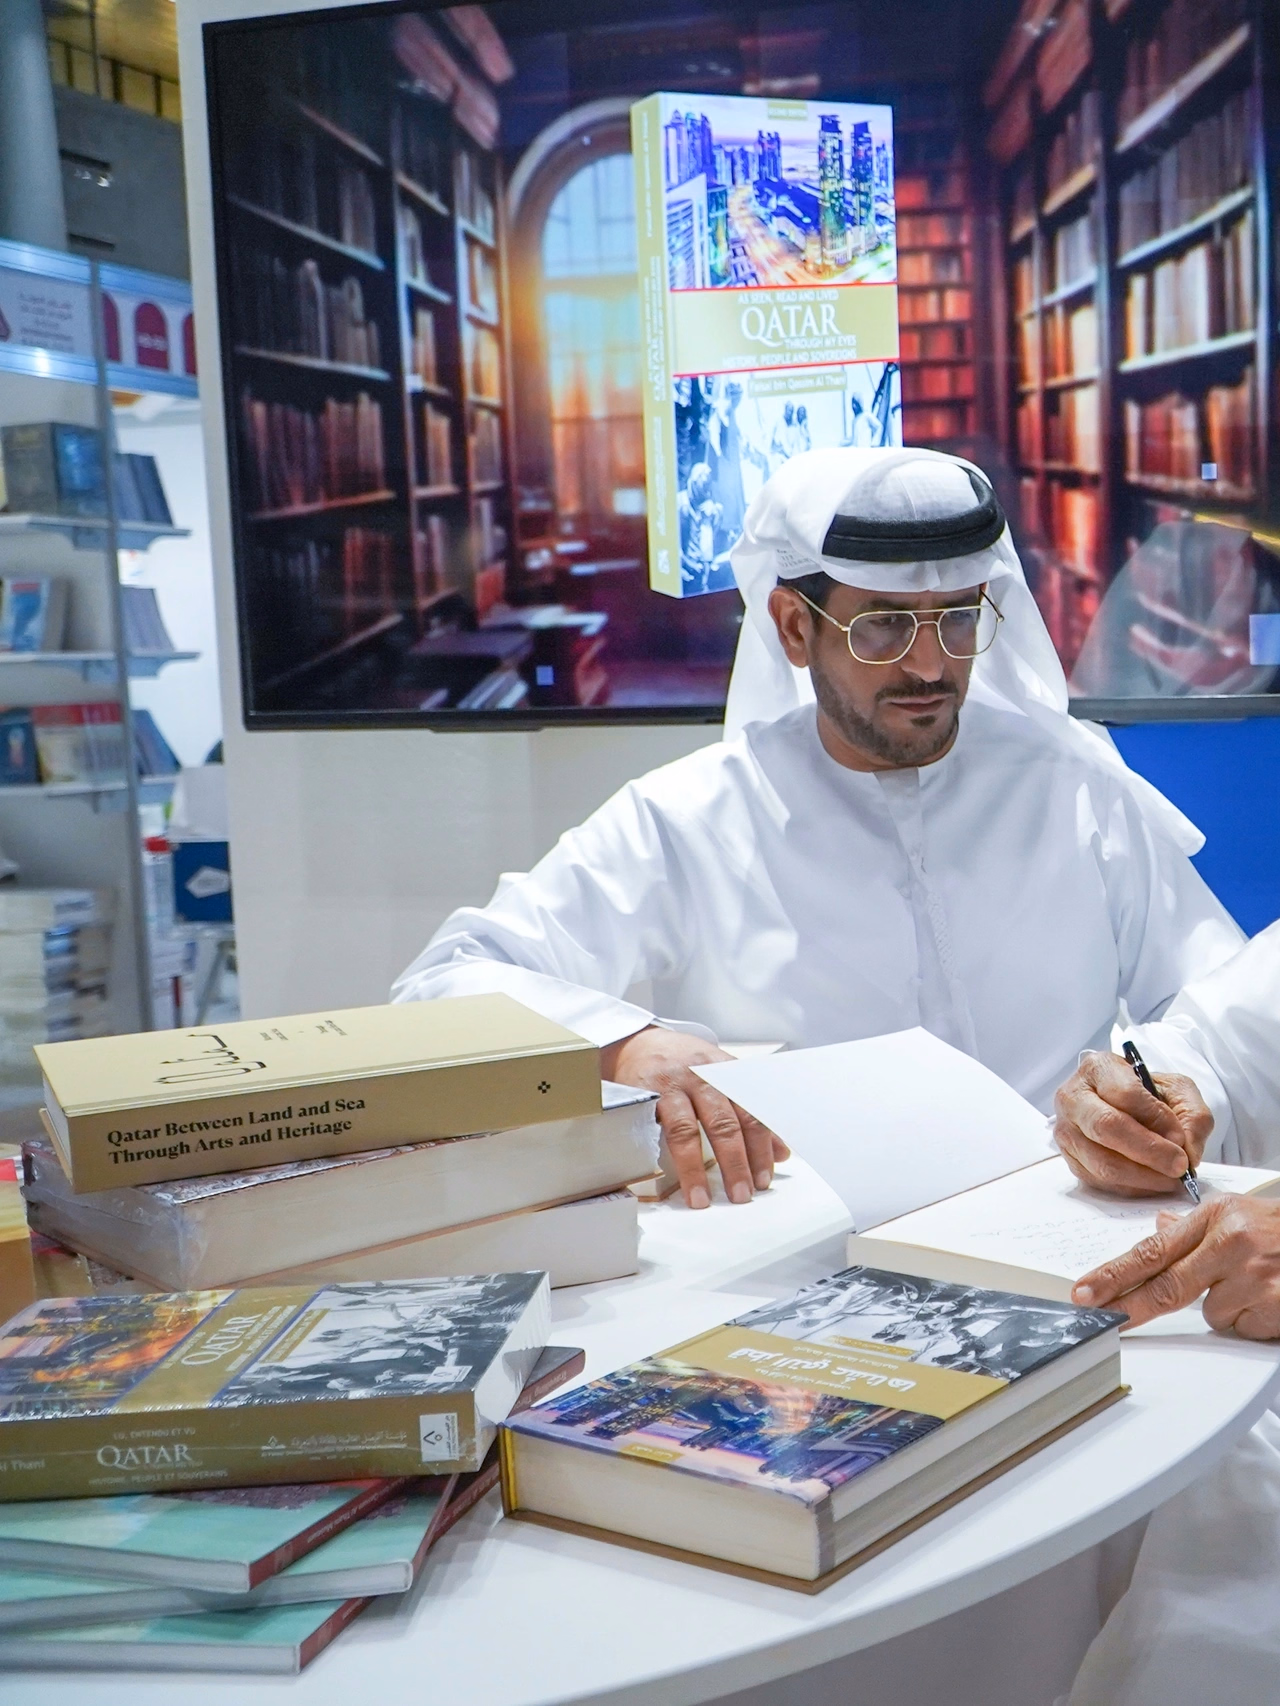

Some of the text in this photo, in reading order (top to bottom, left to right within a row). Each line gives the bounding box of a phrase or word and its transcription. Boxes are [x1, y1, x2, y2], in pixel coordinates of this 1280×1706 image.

[740, 303, 842, 348] QATAR
[838, 334, 857, 347] EYES
[107, 1098, 365, 1147] Qatar Between Land and Sea
[108, 1119, 352, 1165] Through Arts and Heritage
[181, 1313, 263, 1366] QATAR
[11, 1458, 46, 1471] Thani
[96, 1442, 193, 1471] QATAR
